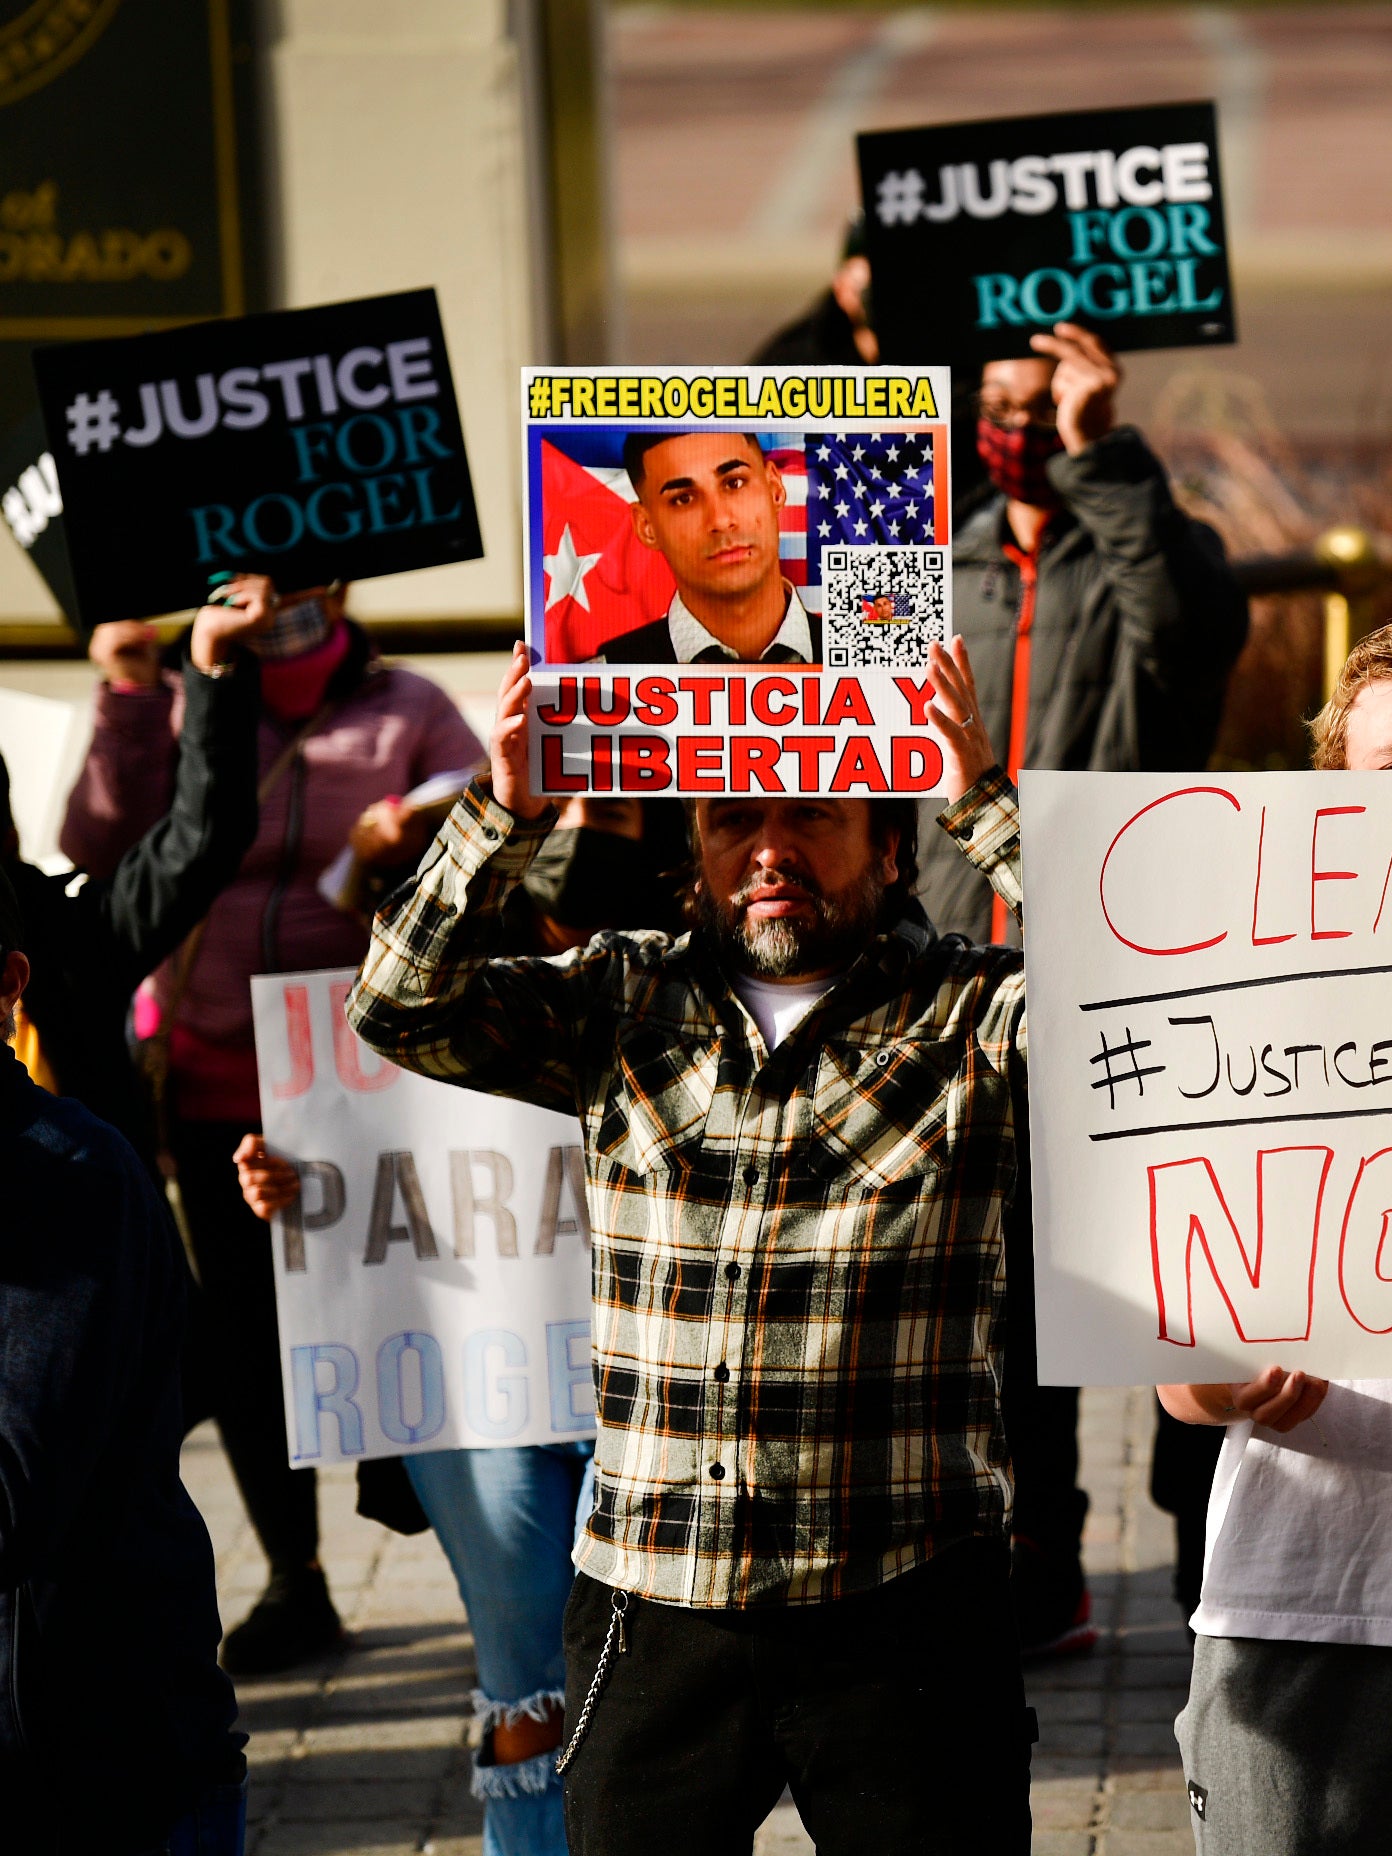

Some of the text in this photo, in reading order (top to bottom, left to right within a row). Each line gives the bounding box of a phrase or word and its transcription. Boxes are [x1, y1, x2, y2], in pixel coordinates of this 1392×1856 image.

[876, 142, 1212, 226] #JUSTICE
[1068, 203, 1221, 264] FOR
[974, 257, 1223, 329] ROGEL
[66, 337, 439, 455] #JUSTICE
[529, 376, 938, 418] #FREEROGELAGUILERA
[289, 404, 454, 481] FOR
[188, 468, 461, 563] ROGEL
[537, 676, 937, 726] JUSTICIA Y
[541, 734, 943, 793] LIBERTAD
[281, 1144, 591, 1273] PARA
